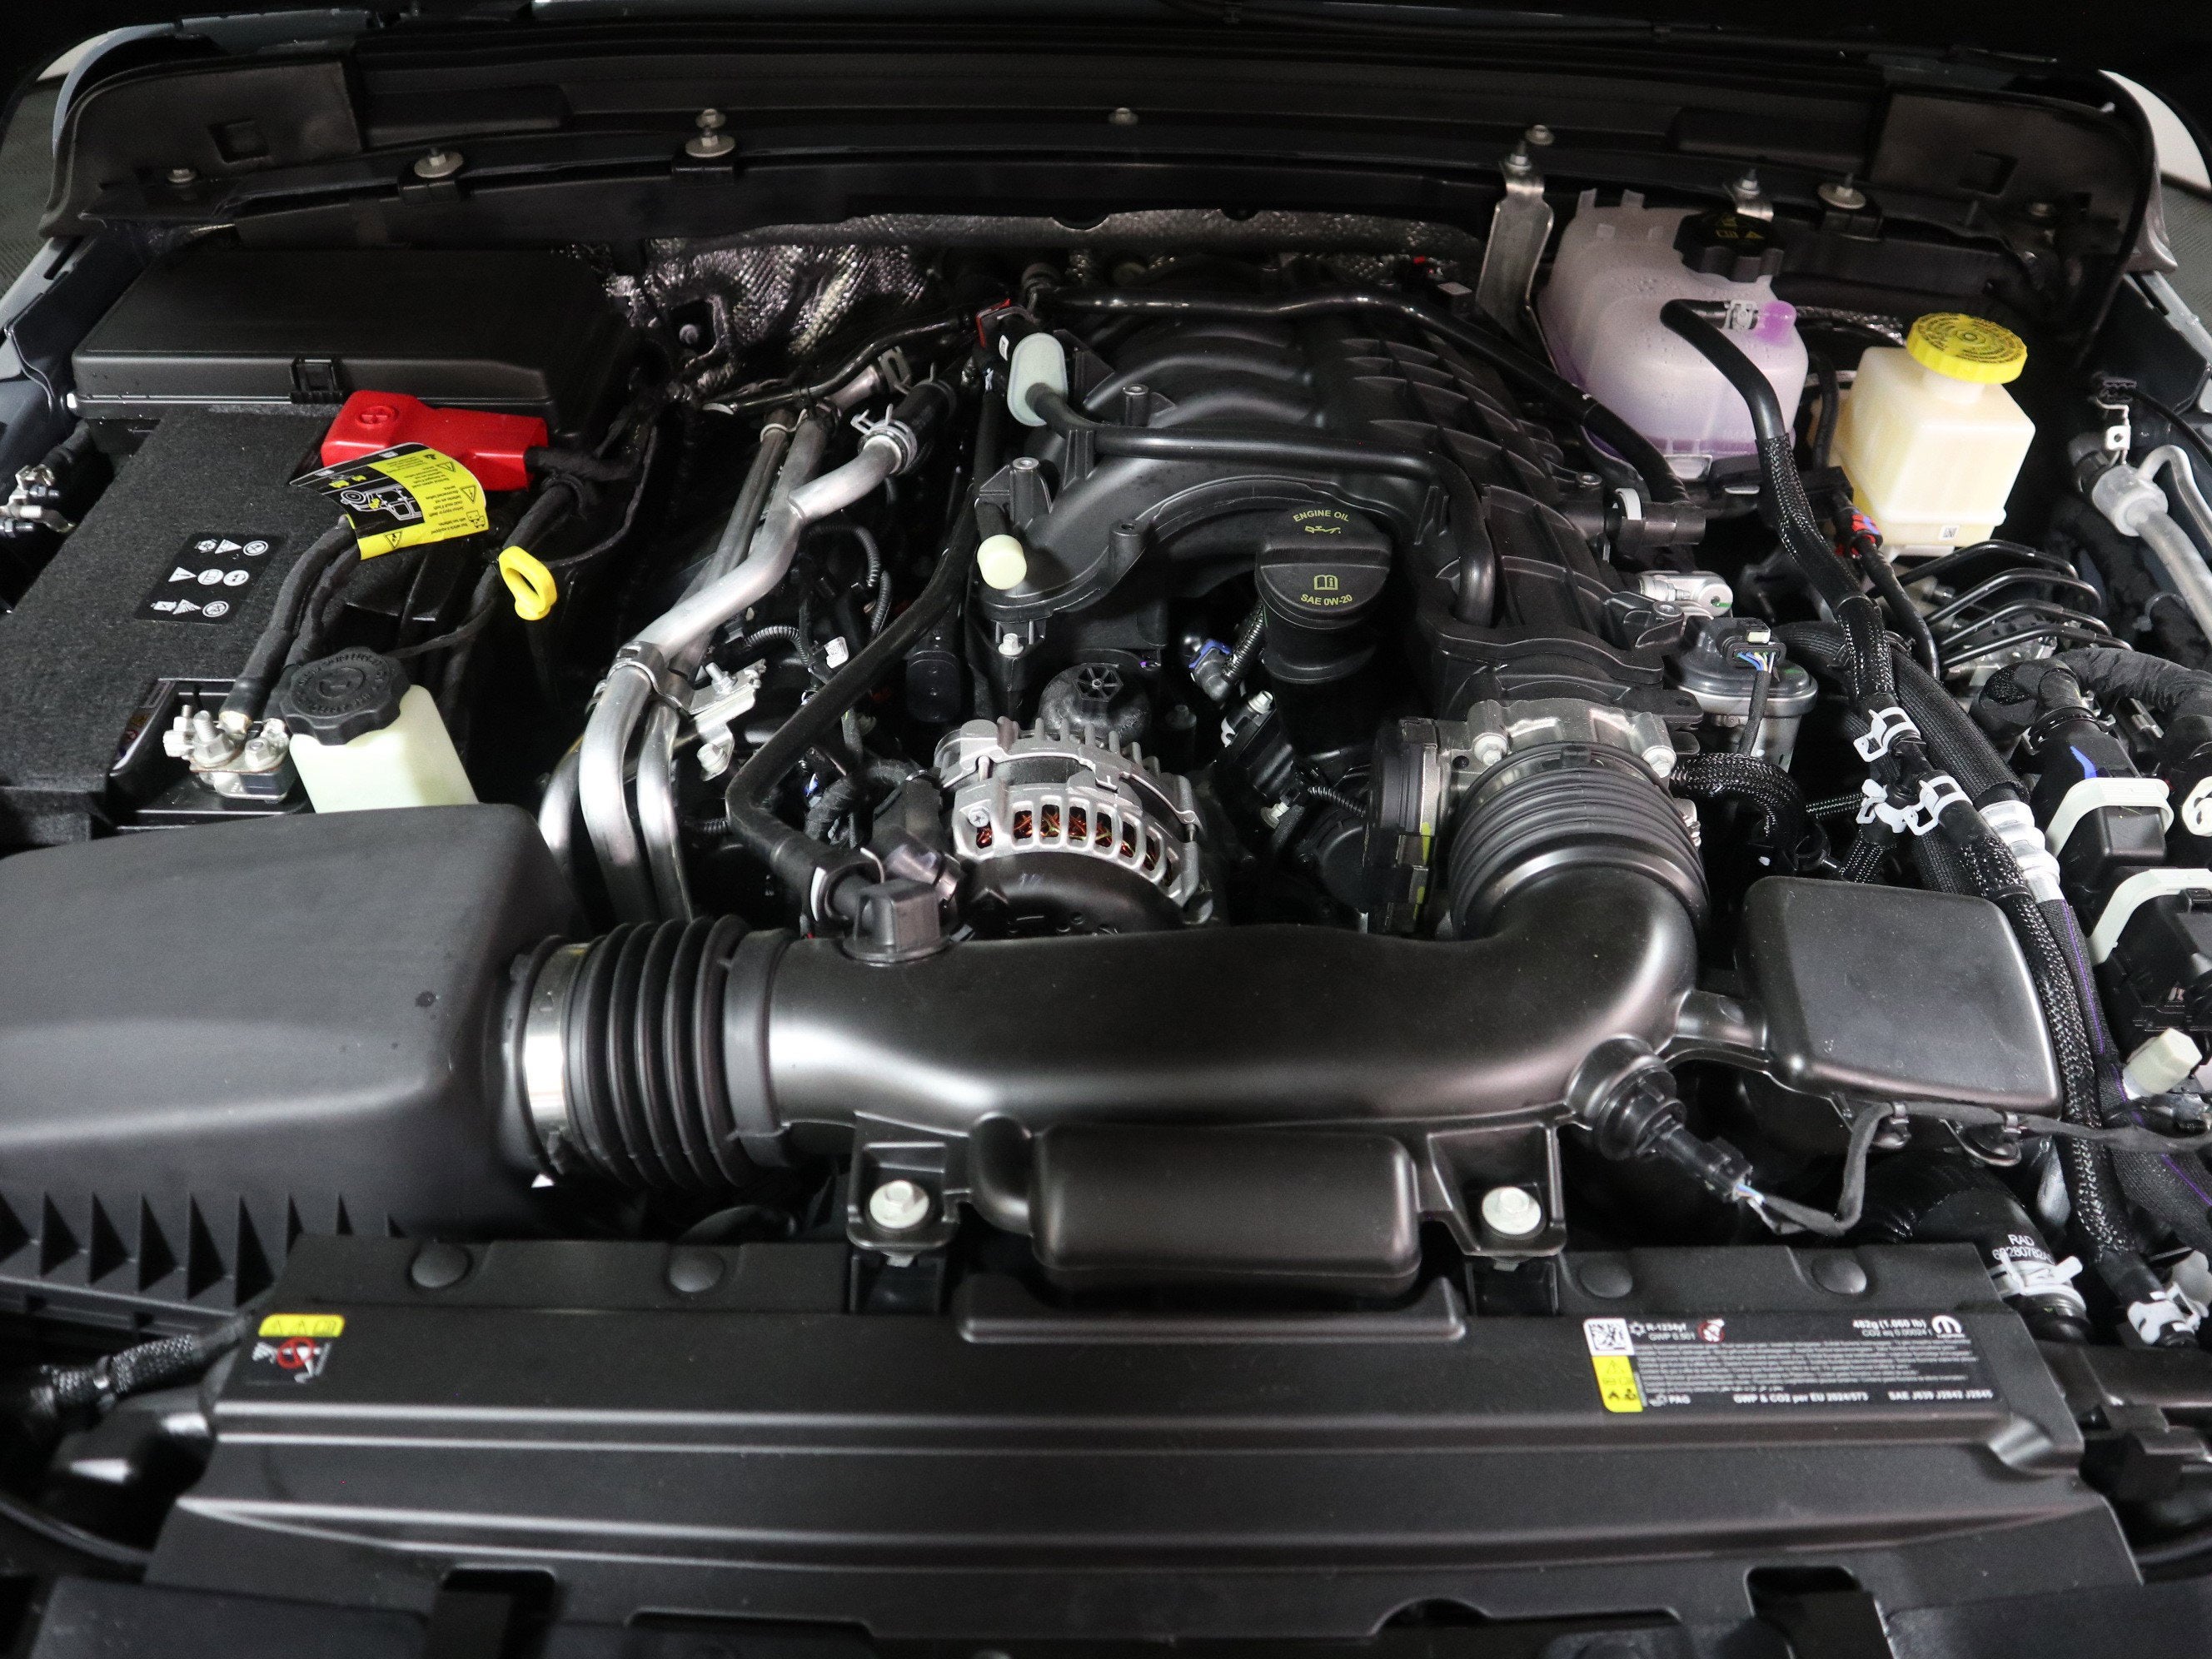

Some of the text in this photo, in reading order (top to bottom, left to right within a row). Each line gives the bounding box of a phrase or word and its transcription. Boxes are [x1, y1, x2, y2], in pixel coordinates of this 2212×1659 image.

[1293, 509, 1350, 522] ENGINE OIL
[1300, 593, 1353, 606] SAE 0W-20
[2007, 1233, 2035, 1247] RAD
